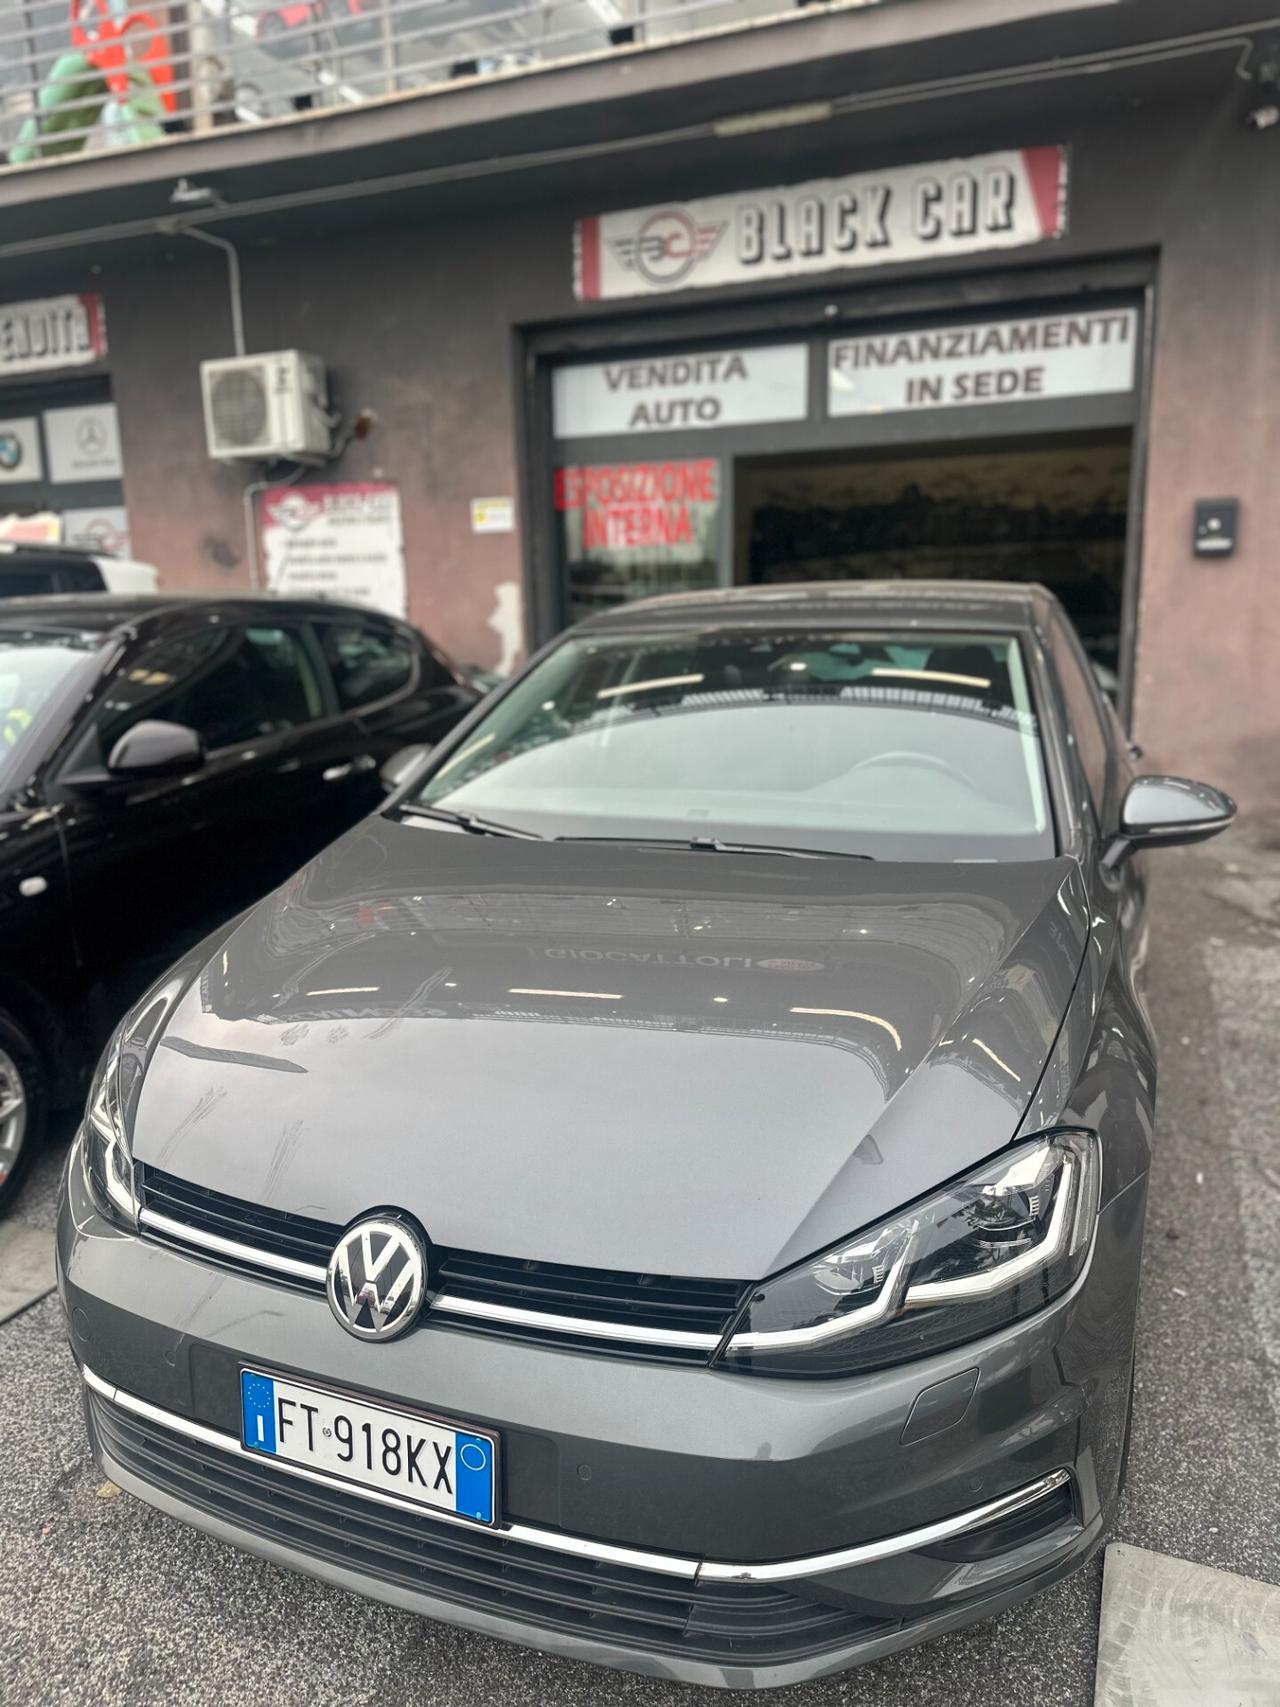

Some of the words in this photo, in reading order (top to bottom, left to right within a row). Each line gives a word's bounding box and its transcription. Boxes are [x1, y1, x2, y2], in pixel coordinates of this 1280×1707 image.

[738, 184, 892, 266] BLACK
[911, 165, 1016, 240] CAR
[833, 315, 1131, 369] FINANZIAMENTI
[603, 352, 748, 392] VENDITA
[904, 376, 944, 404] IN
[952, 366, 1046, 399] SEDE
[629, 396, 722, 428] AUTO
[554, 457, 717, 512] ESPOSIZIONE
[582, 502, 693, 552] INTERNA
